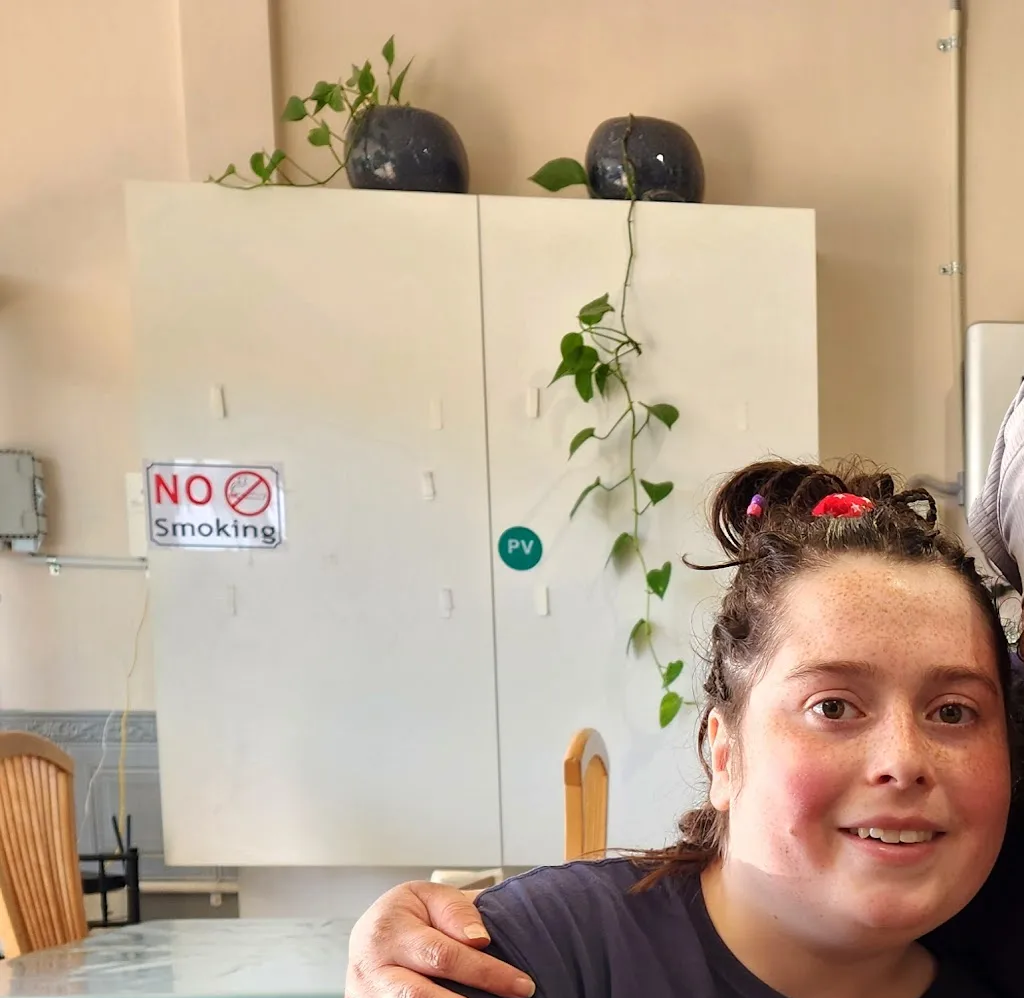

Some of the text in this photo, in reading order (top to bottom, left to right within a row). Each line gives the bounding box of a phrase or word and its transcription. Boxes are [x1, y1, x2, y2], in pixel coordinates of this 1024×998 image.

[155, 473, 213, 506] NO
[155, 518, 276, 545] Smoking
[507, 538, 534, 555] PV
